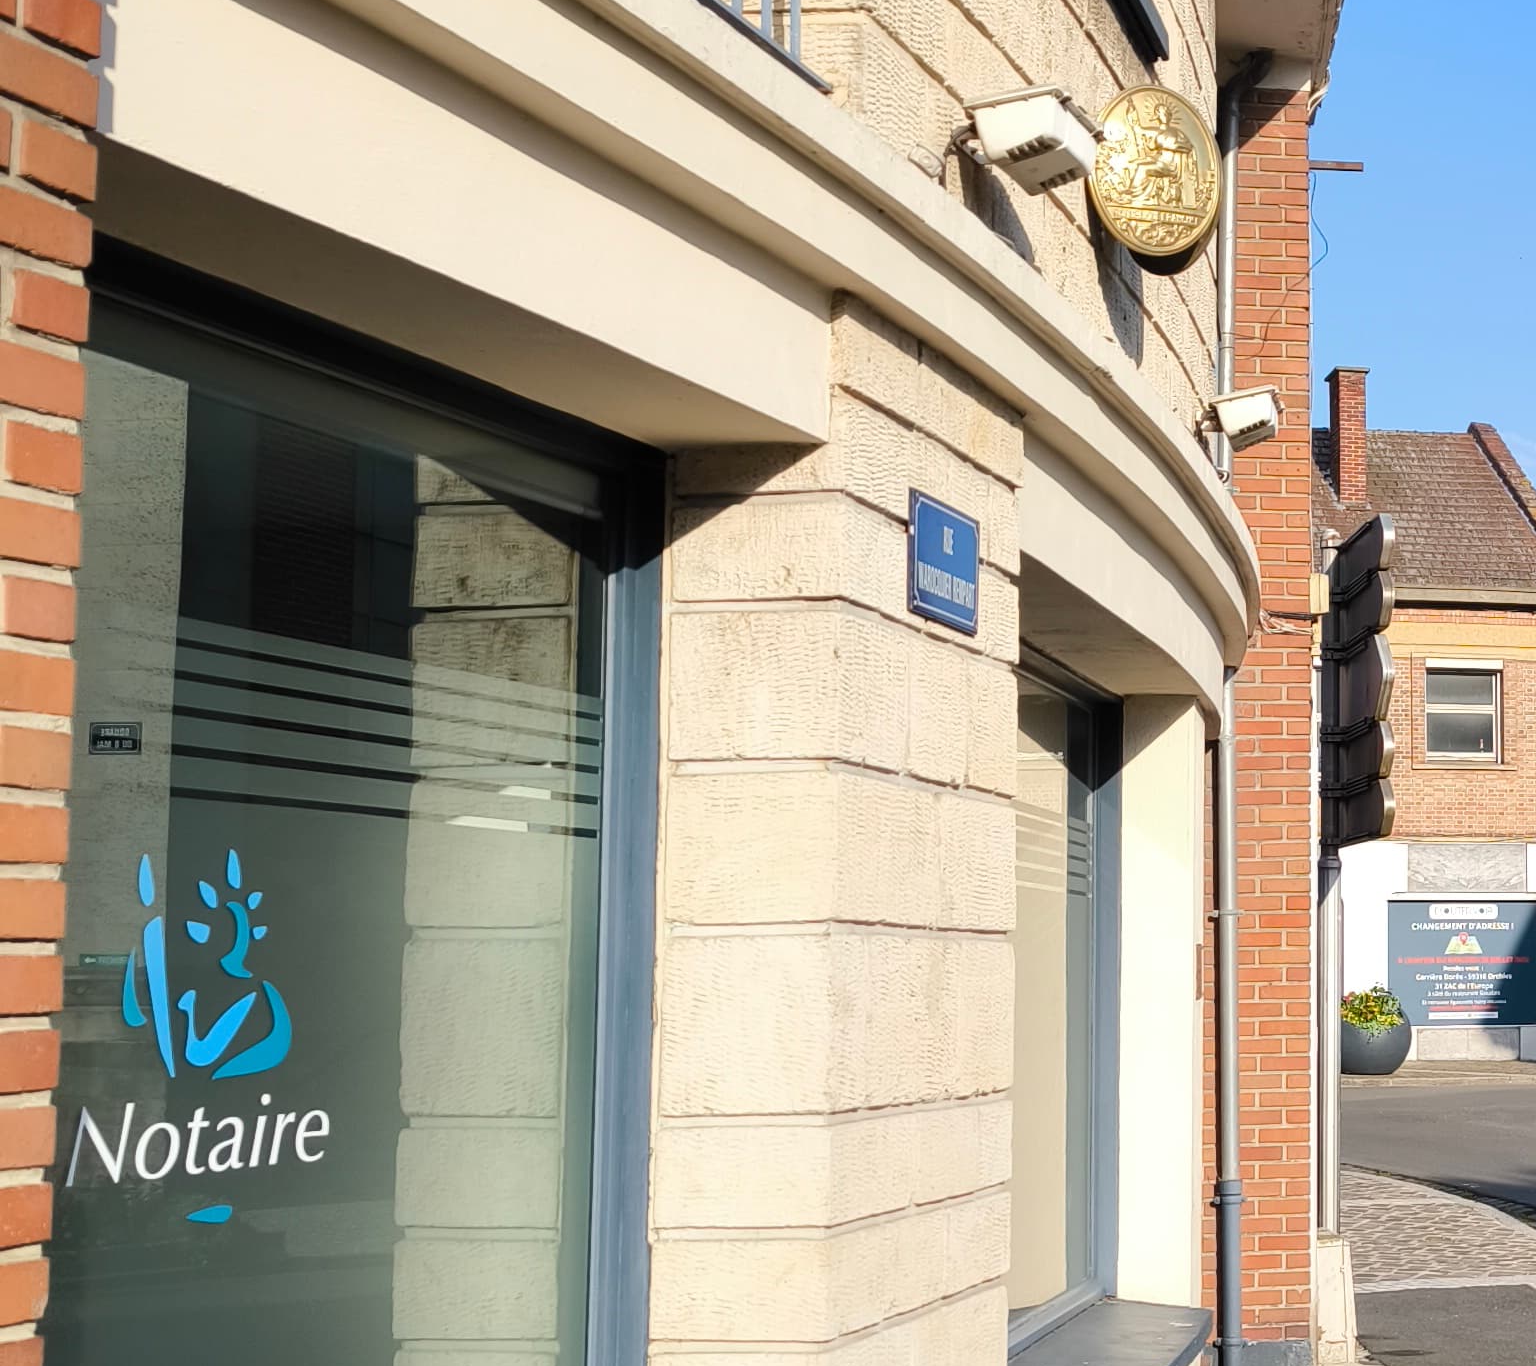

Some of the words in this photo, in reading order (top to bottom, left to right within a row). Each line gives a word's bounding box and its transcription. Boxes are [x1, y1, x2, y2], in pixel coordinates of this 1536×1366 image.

[1411, 922, 1467, 931] CHANGEMENT
[1468, 922, 1509, 930] D'ADRESSE
[65, 1093, 331, 1188] Notaire
